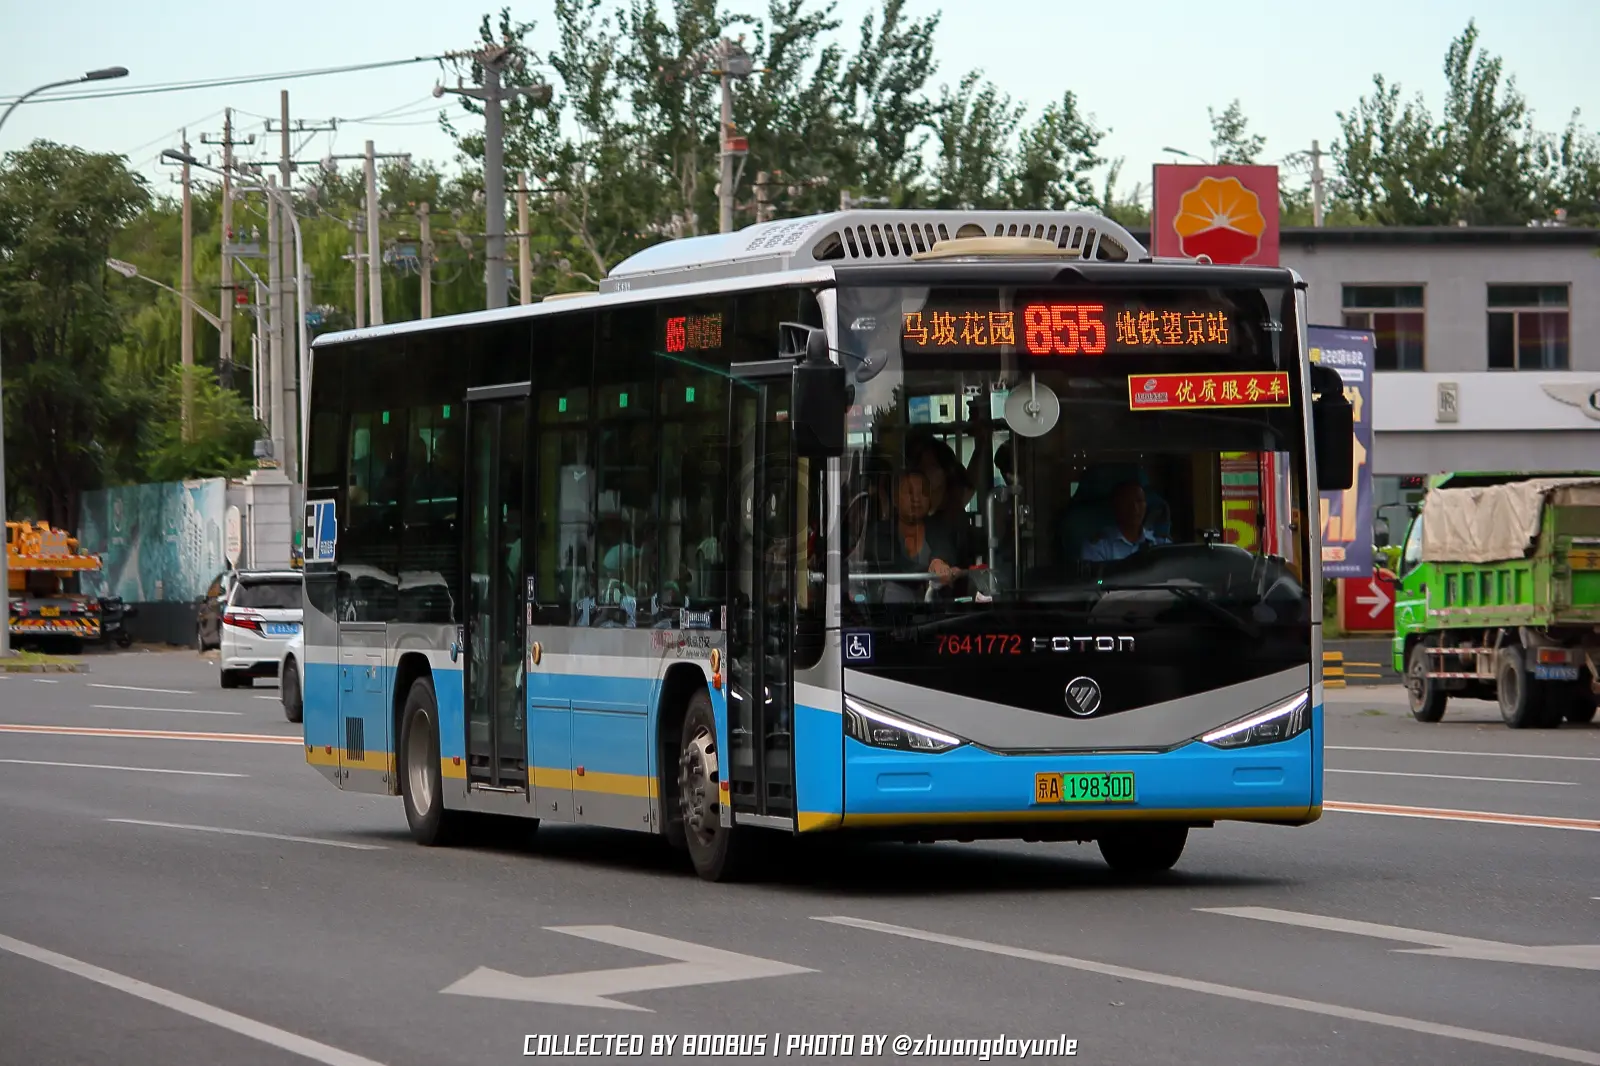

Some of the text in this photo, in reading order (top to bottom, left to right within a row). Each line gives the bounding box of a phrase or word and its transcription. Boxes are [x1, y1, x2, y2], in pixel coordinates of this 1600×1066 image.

[903, 311, 1015, 346] 马坡花园
[1024, 304, 1107, 354] 855
[1115, 311, 1229, 346] 地铁望京站
[1175, 377, 1285, 403] 优质服务车
[936, 634, 1021, 654] 7641772
[1031, 636, 1136, 652] FOTON
[1038, 777, 1132, 798] 京A 19830D
